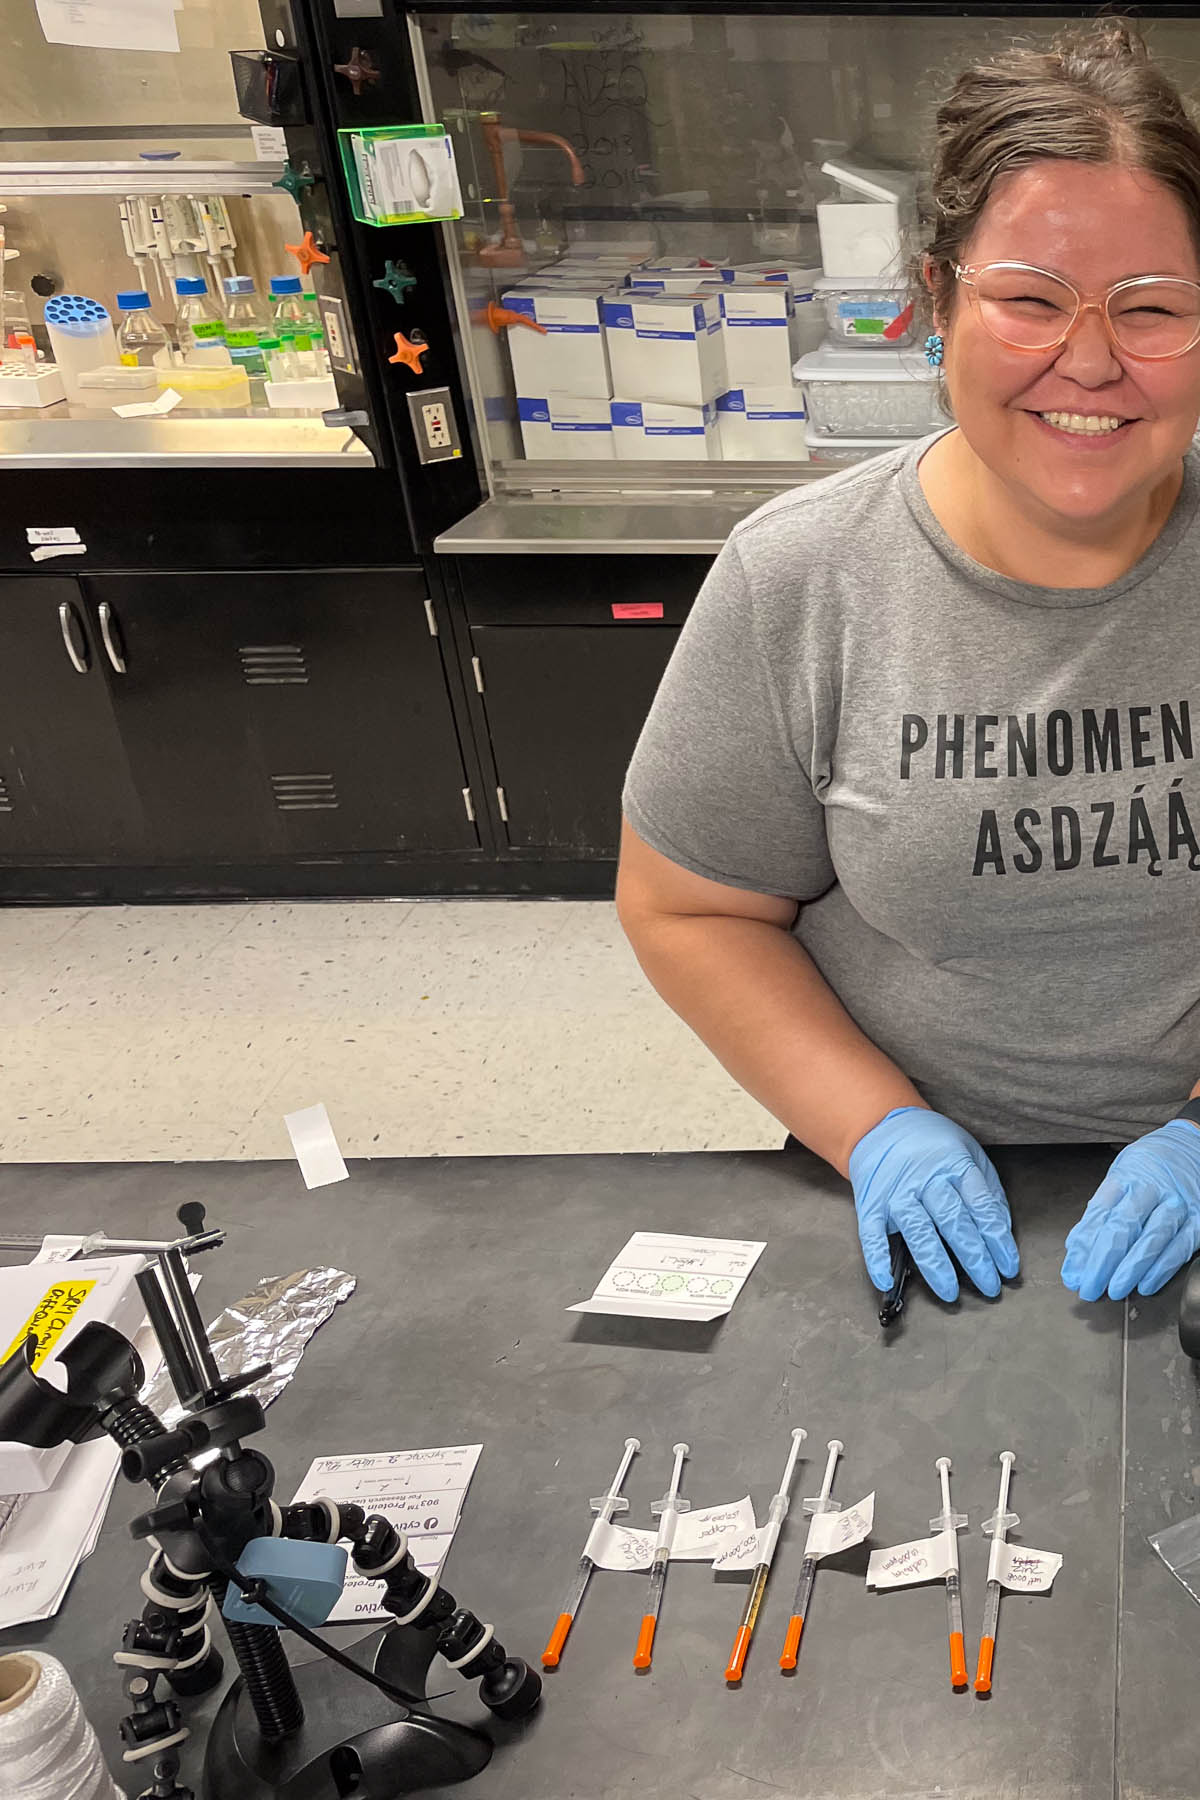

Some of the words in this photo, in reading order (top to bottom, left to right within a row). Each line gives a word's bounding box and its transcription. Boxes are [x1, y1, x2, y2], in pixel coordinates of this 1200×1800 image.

[376, 1495, 406, 1503] Research
[366, 1500, 406, 1511] Protein
[391, 1517, 421, 1531] cytiv
